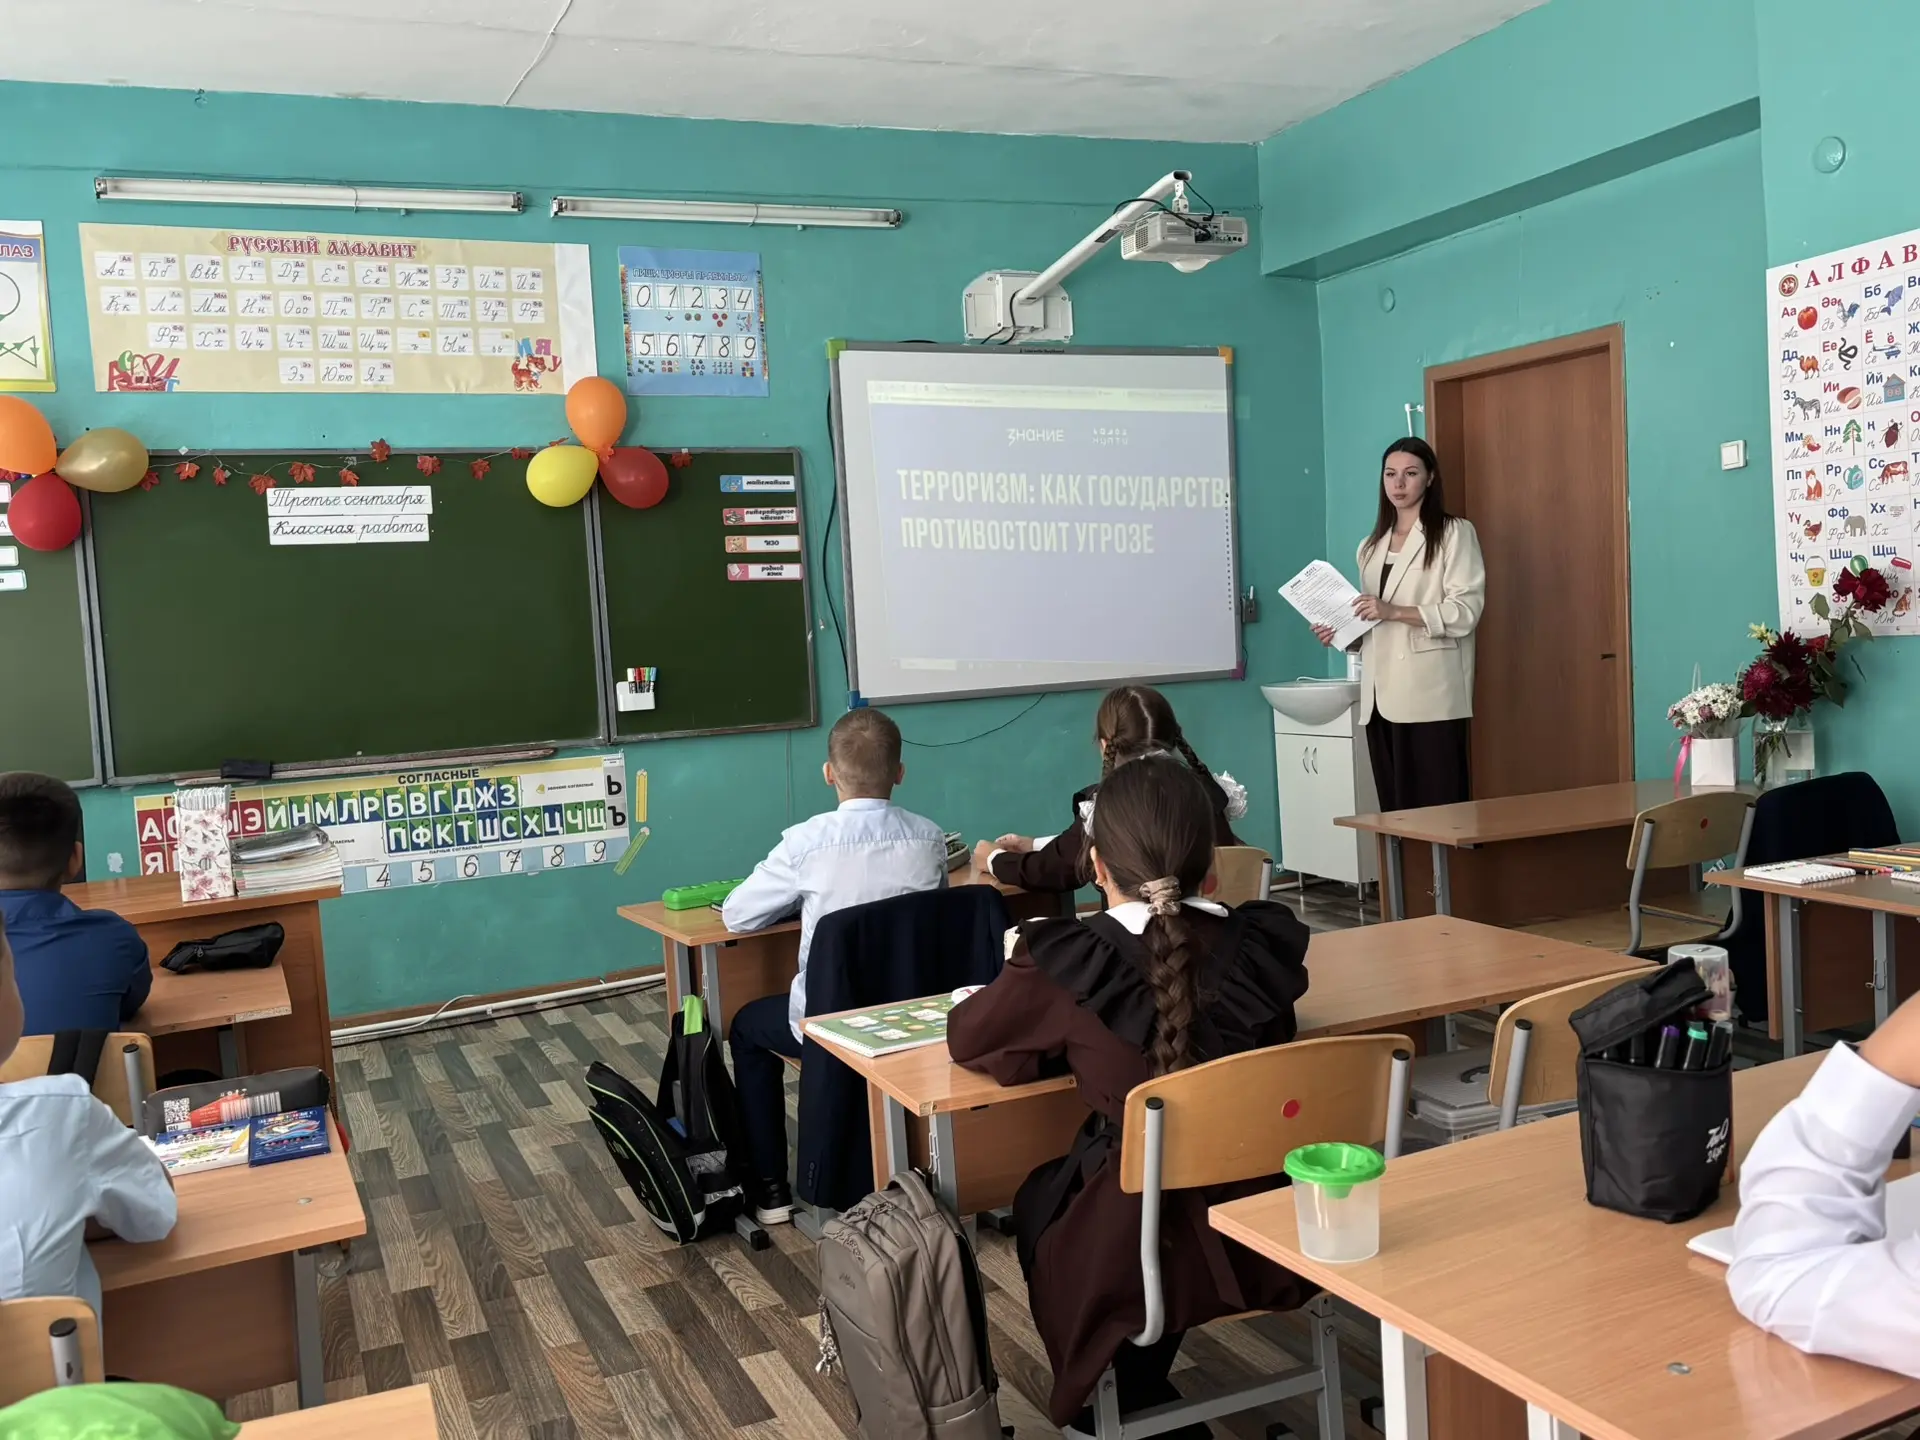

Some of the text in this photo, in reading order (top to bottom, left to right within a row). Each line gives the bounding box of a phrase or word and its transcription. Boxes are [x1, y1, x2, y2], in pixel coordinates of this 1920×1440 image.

[228, 235, 416, 258] РУССКИЙ АЛФАВИТ
[633, 268, 660, 279] ПИШИ
[661, 269, 694, 280] ЦИФРЫ
[1804, 244, 1920, 288] АЛФАВ
[1006, 428, 1065, 446] ЗНАНИЕ
[269, 486, 425, 513] Третье сентября
[896, 468, 1229, 511] ТЕРРОРИЗМ: КАК ГОСУДАРСТВ
[273, 516, 426, 540] Классная работа
[901, 517, 1154, 554] ПРОТИВОСТОИТ УГРОЗЕ
[397, 768, 480, 785] СОГЛАСНЫЕ
